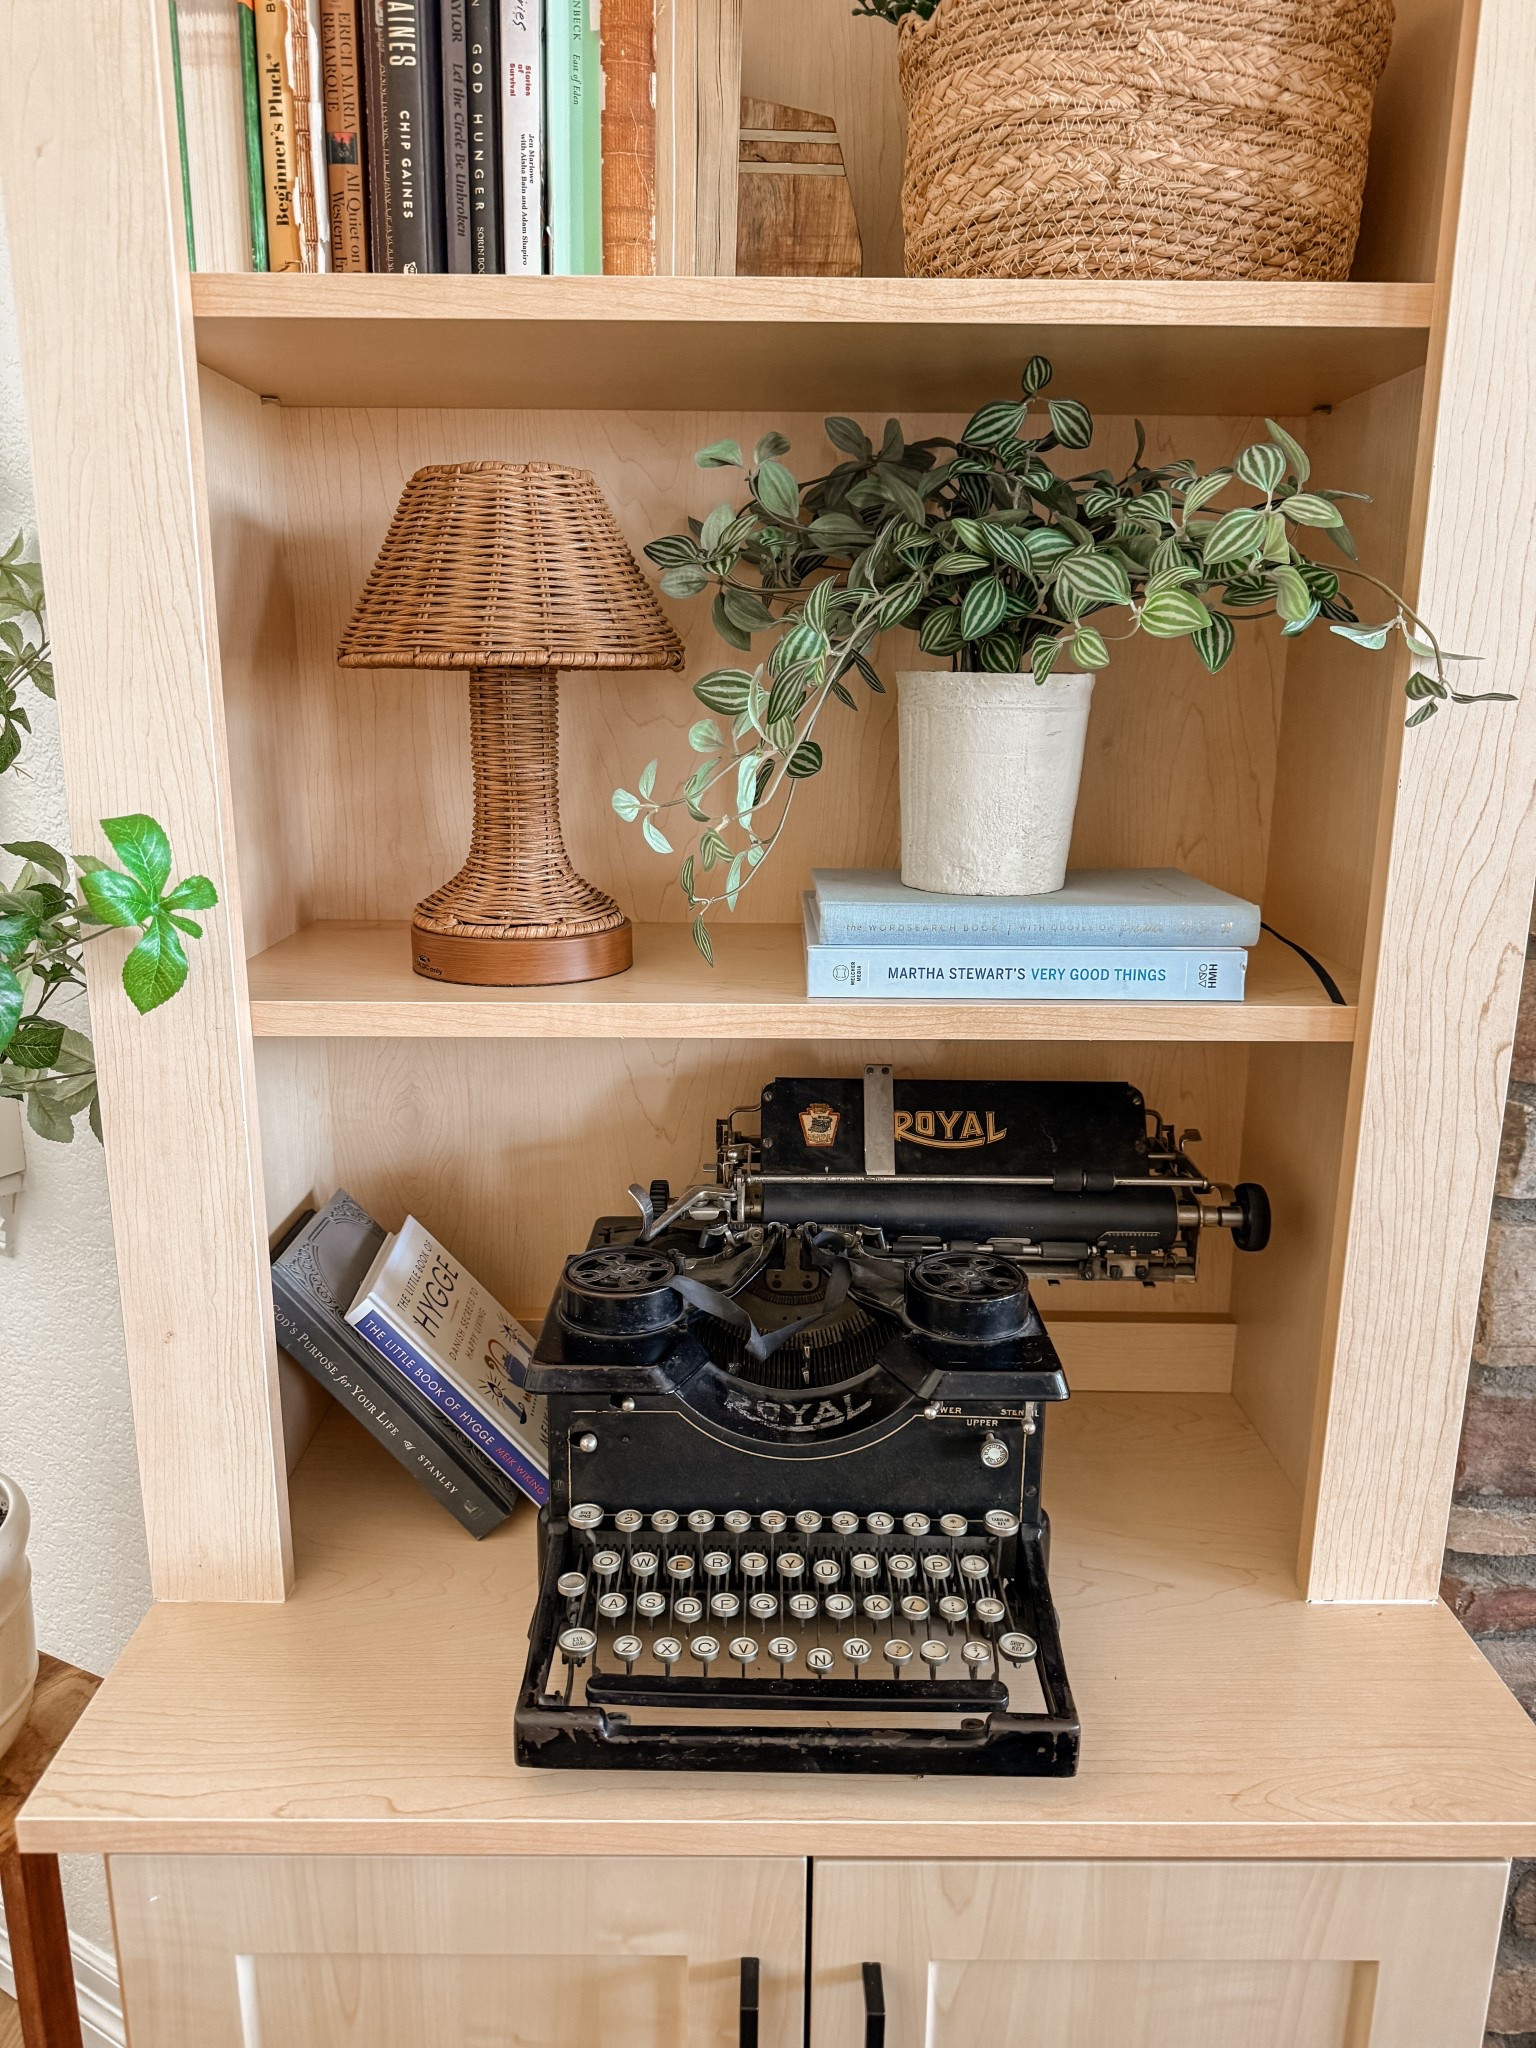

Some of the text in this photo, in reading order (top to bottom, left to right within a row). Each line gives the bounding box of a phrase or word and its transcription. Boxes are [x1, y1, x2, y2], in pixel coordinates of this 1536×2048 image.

[323, 12, 340, 113] REMARQUE
[339, 12, 356, 130] ERICH MARIA
[518, 64, 524, 73] of
[571, 54, 581, 105] East of Eden
[452, 63, 468, 237] Let the Circle Be Unbroken
[472, 44, 485, 211] GOD HUNGER
[270, 123, 292, 226] Beginner's
[400, 110, 414, 219] CHIP GAINES
[332, 191, 345, 251] Western
[346, 171, 362, 263] All Quiet on
[477, 226, 485, 256] SORIN
[521, 235, 529, 266] Shapiro
[846, 924, 998, 932] the WORDSEARCH BOOK
[430, 967, 443, 975] only
[888, 967, 1166, 981] MARTHA STEWART'S VERY GOOD THINGS
[1207, 964, 1218, 989] HMH
[894, 1110, 1007, 1149] ROYAL
[396, 1239, 433, 1312] THE LITTLE BOOK OF
[412, 1254, 459, 1338] HYGGE
[450, 1287, 479, 1361] DANISH SECRETS TO
[465, 1307, 487, 1360] HAPPY LIVING
[297, 1333, 339, 1375] PURPOSE
[334, 1375, 352, 1388] for
[351, 1384, 378, 1415] YOUR
[376, 1411, 400, 1436] LIFE
[365, 1319, 495, 1446] THE LITTLE BOOK OF HYGGE
[940, 1407, 1039, 1418] WER STENIL
[966, 1419, 999, 1427] UPPER
[418, 1454, 459, 1494] STANLEY
[496, 1447, 545, 1495] MEIK WIKING
[636, 1557, 651, 1567] W
[712, 1557, 723, 1567] R
[747, 1558, 759, 1568] T
[785, 1559, 795, 1568] Y
[821, 1566, 834, 1576] U
[894, 1560, 908, 1569] O
[931, 1561, 943, 1571] P
[608, 1598, 618, 1608] A
[645, 1598, 656, 1607] S
[682, 1603, 695, 1613] D
[720, 1599, 731, 1609] F
[756, 1599, 770, 1609] G
[798, 1600, 809, 1610] H
[872, 1601, 883, 1611] K
[908, 1601, 920, 1612] L
[622, 1642, 864, 1665] Z X C V B N M
